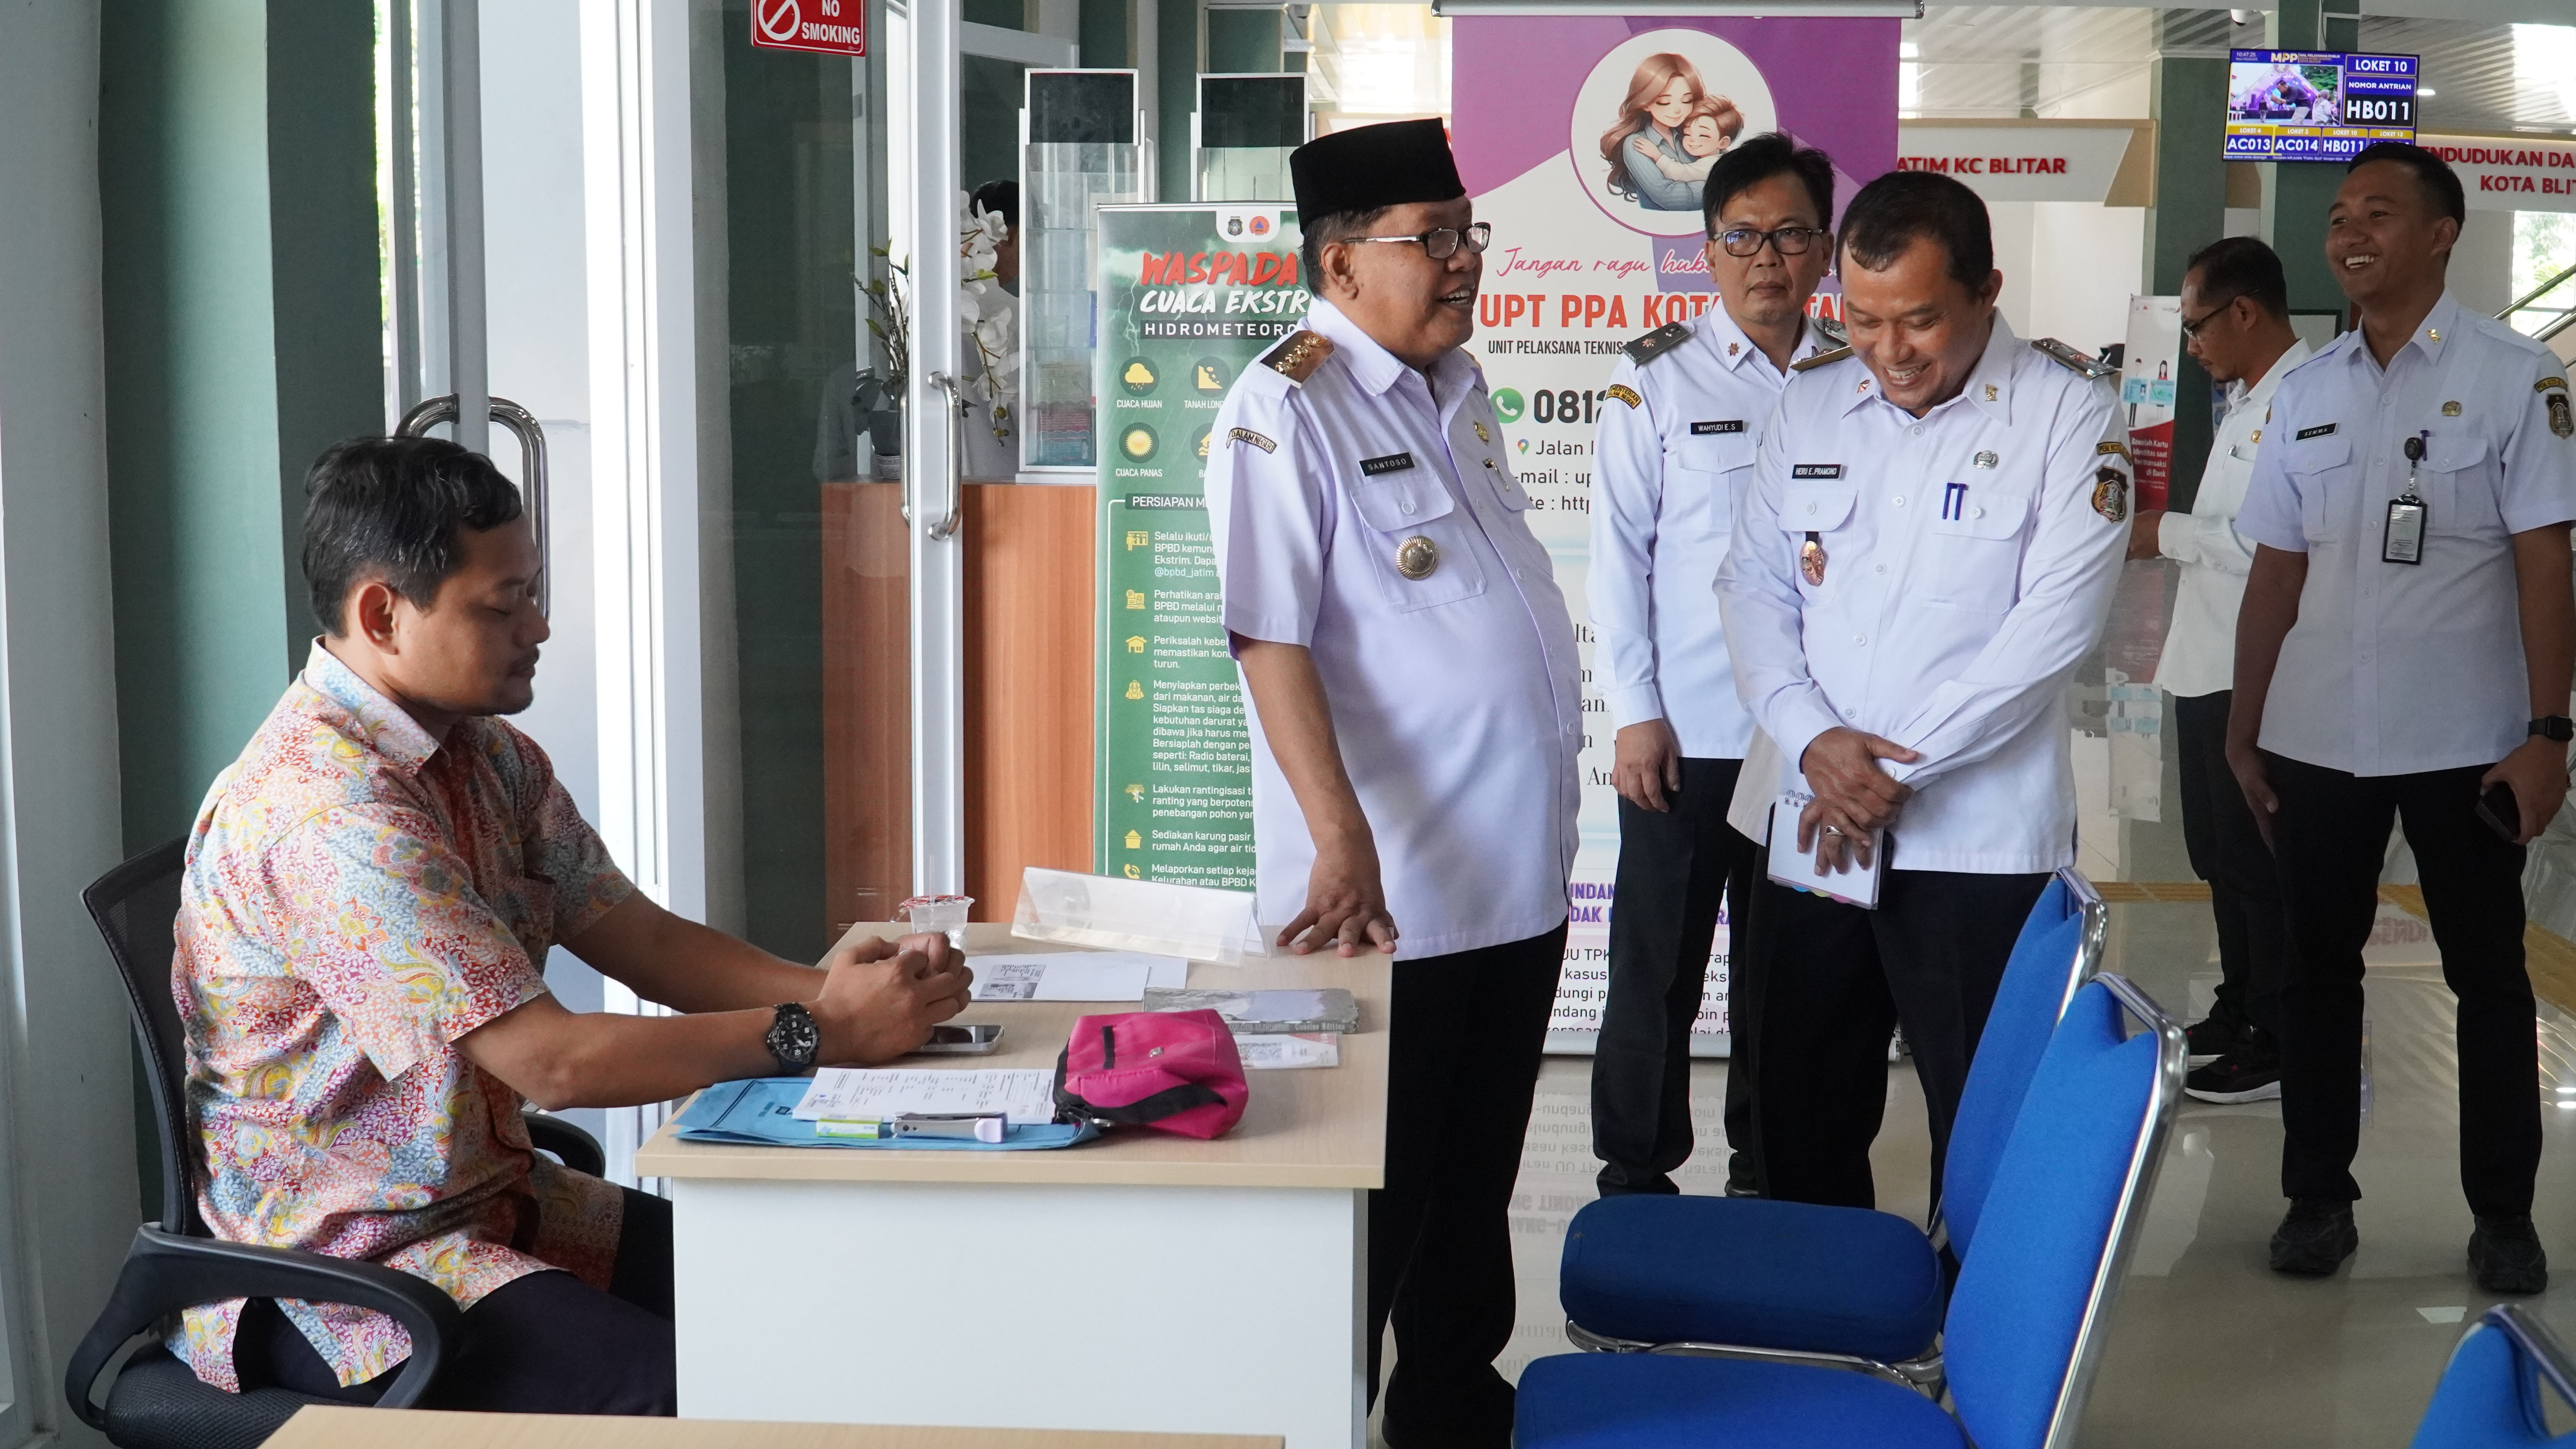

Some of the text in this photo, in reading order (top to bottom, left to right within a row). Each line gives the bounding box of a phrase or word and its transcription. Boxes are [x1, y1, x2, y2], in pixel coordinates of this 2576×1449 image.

[822, 0, 840, 17] NO
[802, 22, 860, 44] SMOKING
[2271, 53, 2298, 63] MPP
[2356, 60, 2407, 72] LOKET 10
[2347, 100, 2409, 120] HB011
[2227, 138, 2270, 150] AC013
[2275, 139, 2318, 151] AC014
[2323, 139, 2363, 152] HB011
[2419, 146, 2576, 168] NDUDUKAN DA
[1954, 158, 1983, 174] KC
[1989, 158, 2066, 174] BLITAR
[2481, 176, 2535, 192] KOTA
[1141, 251, 1297, 286] WASPADA
[1497, 247, 1583, 279] Jangan
[1593, 261, 1650, 279] ragu
[1140, 289, 1312, 314] CUACA EKSTR
[1480, 294, 1721, 328] UPT PPA KOT
[1488, 340, 1623, 355] UNIT PELAKSANA TEKNIS
[1117, 400, 1140, 408] CUACA
[1232, 430, 1274, 451] DALAM NEGERI
[2154, 440, 2168, 448] Kartu
[1536, 440, 1583, 455] Jalan
[1367, 458, 1406, 471] SANTOSO
[2135, 458, 2166, 467] bertransaksi
[1116, 468, 1163, 477] CUACA PANAS
[2153, 469, 2166, 477] Bank
[1133, 496, 1193, 507] PERSIAPAN
[1154, 531, 1183, 540] Selalu
[1155, 543, 1180, 552] BPBD
[1154, 555, 1217, 566] Ekstrim. Dapa
[1154, 567, 1214, 578] @bpbd_jatim
[1154, 589, 1202, 599] Perhatikan
[1154, 601, 1179, 610] BPBD
[1182, 602, 1215, 611] melalui
[1154, 614, 1222, 624] ataupun websit
[1154, 636, 1201, 645] Periksalah
[1154, 649, 1209, 657] memastikan
[1154, 660, 1180, 668] turun.
[1153, 680, 1240, 691] Menyiapkan perbek
[1153, 692, 1170, 700] dari
[1173, 693, 1216, 703] makanan,
[1218, 694, 1230, 702] air
[1153, 703, 1188, 713] Siapkan
[1191, 705, 1205, 713] tas
[1207, 706, 1231, 715] siaga
[1153, 715, 1200, 724] kebutuhan
[1203, 716, 1236, 725] darurat
[1153, 727, 1185, 736] dibawa
[1187, 728, 1203, 737] jika
[1205, 728, 1230, 737] harus
[1153, 739, 1252, 751] Bersiaplah dengan pe
[1153, 751, 1250, 762] seperti: Radio baterai,
[1153, 762, 1250, 774] lilin, selimut, tikar, jas
[1153, 785, 1190, 794] Lakukan
[1193, 786, 1245, 796] rantingisasi
[1153, 797, 1184, 806] ranting
[1187, 798, 1208, 807] yang
[1153, 808, 1207, 818] penebangan
[1209, 810, 1237, 819] pohon
[1152, 830, 1251, 842] Sediakan karung pasir
[1152, 842, 1181, 851] rumah
[1183, 843, 1206, 852] Anda
[1208, 845, 1228, 853] agar
[1230, 844, 1242, 852] air
[1152, 864, 1256, 876] Melaporkan setiap keja
[1152, 876, 1197, 885] Kelurahan
[1222, 877, 1247, 887] BPBD
[1565, 967, 1607, 979] kasus
[1550, 1006, 1596, 1021] ndang
